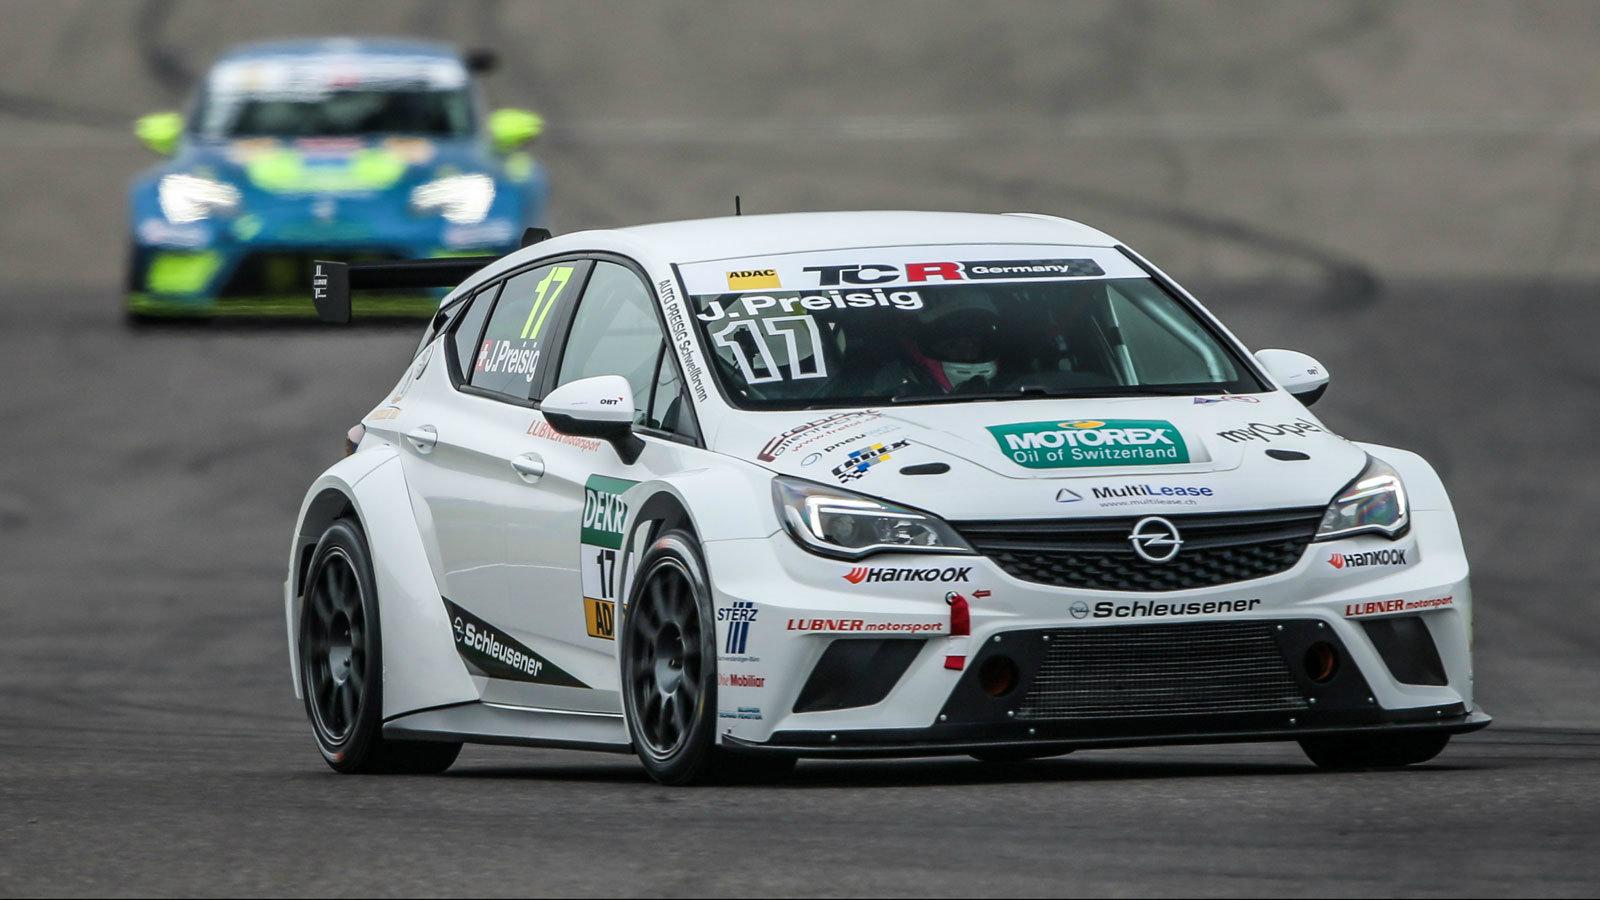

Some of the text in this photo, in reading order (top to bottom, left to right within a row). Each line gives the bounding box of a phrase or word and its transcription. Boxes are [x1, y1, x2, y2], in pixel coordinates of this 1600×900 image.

[729, 269, 776, 279] ADAC
[802, 261, 1069, 287] TCR Germany
[520, 267, 575, 340] 17
[659, 279, 708, 403] AUTO PREISIG Schwellbrunn
[712, 314, 828, 385] 17
[1003, 428, 1175, 450] MOTOREX
[1013, 446, 1177, 463] Oil of Switzerland
[1091, 484, 1214, 499] MultiLease
[582, 489, 628, 534] DEKR
[1099, 498, 1198, 508] www.multilease.ch
[596, 549, 616, 598] 17
[717, 608, 758, 622] STERZ
[1092, 600, 1261, 618] Schleusener
[1345, 596, 1453, 617] LUBNER motorsport
[595, 601, 615, 637] AD
[786, 618, 943, 634] LUBNER motorsport
[464, 623, 543, 677] Schleusener
